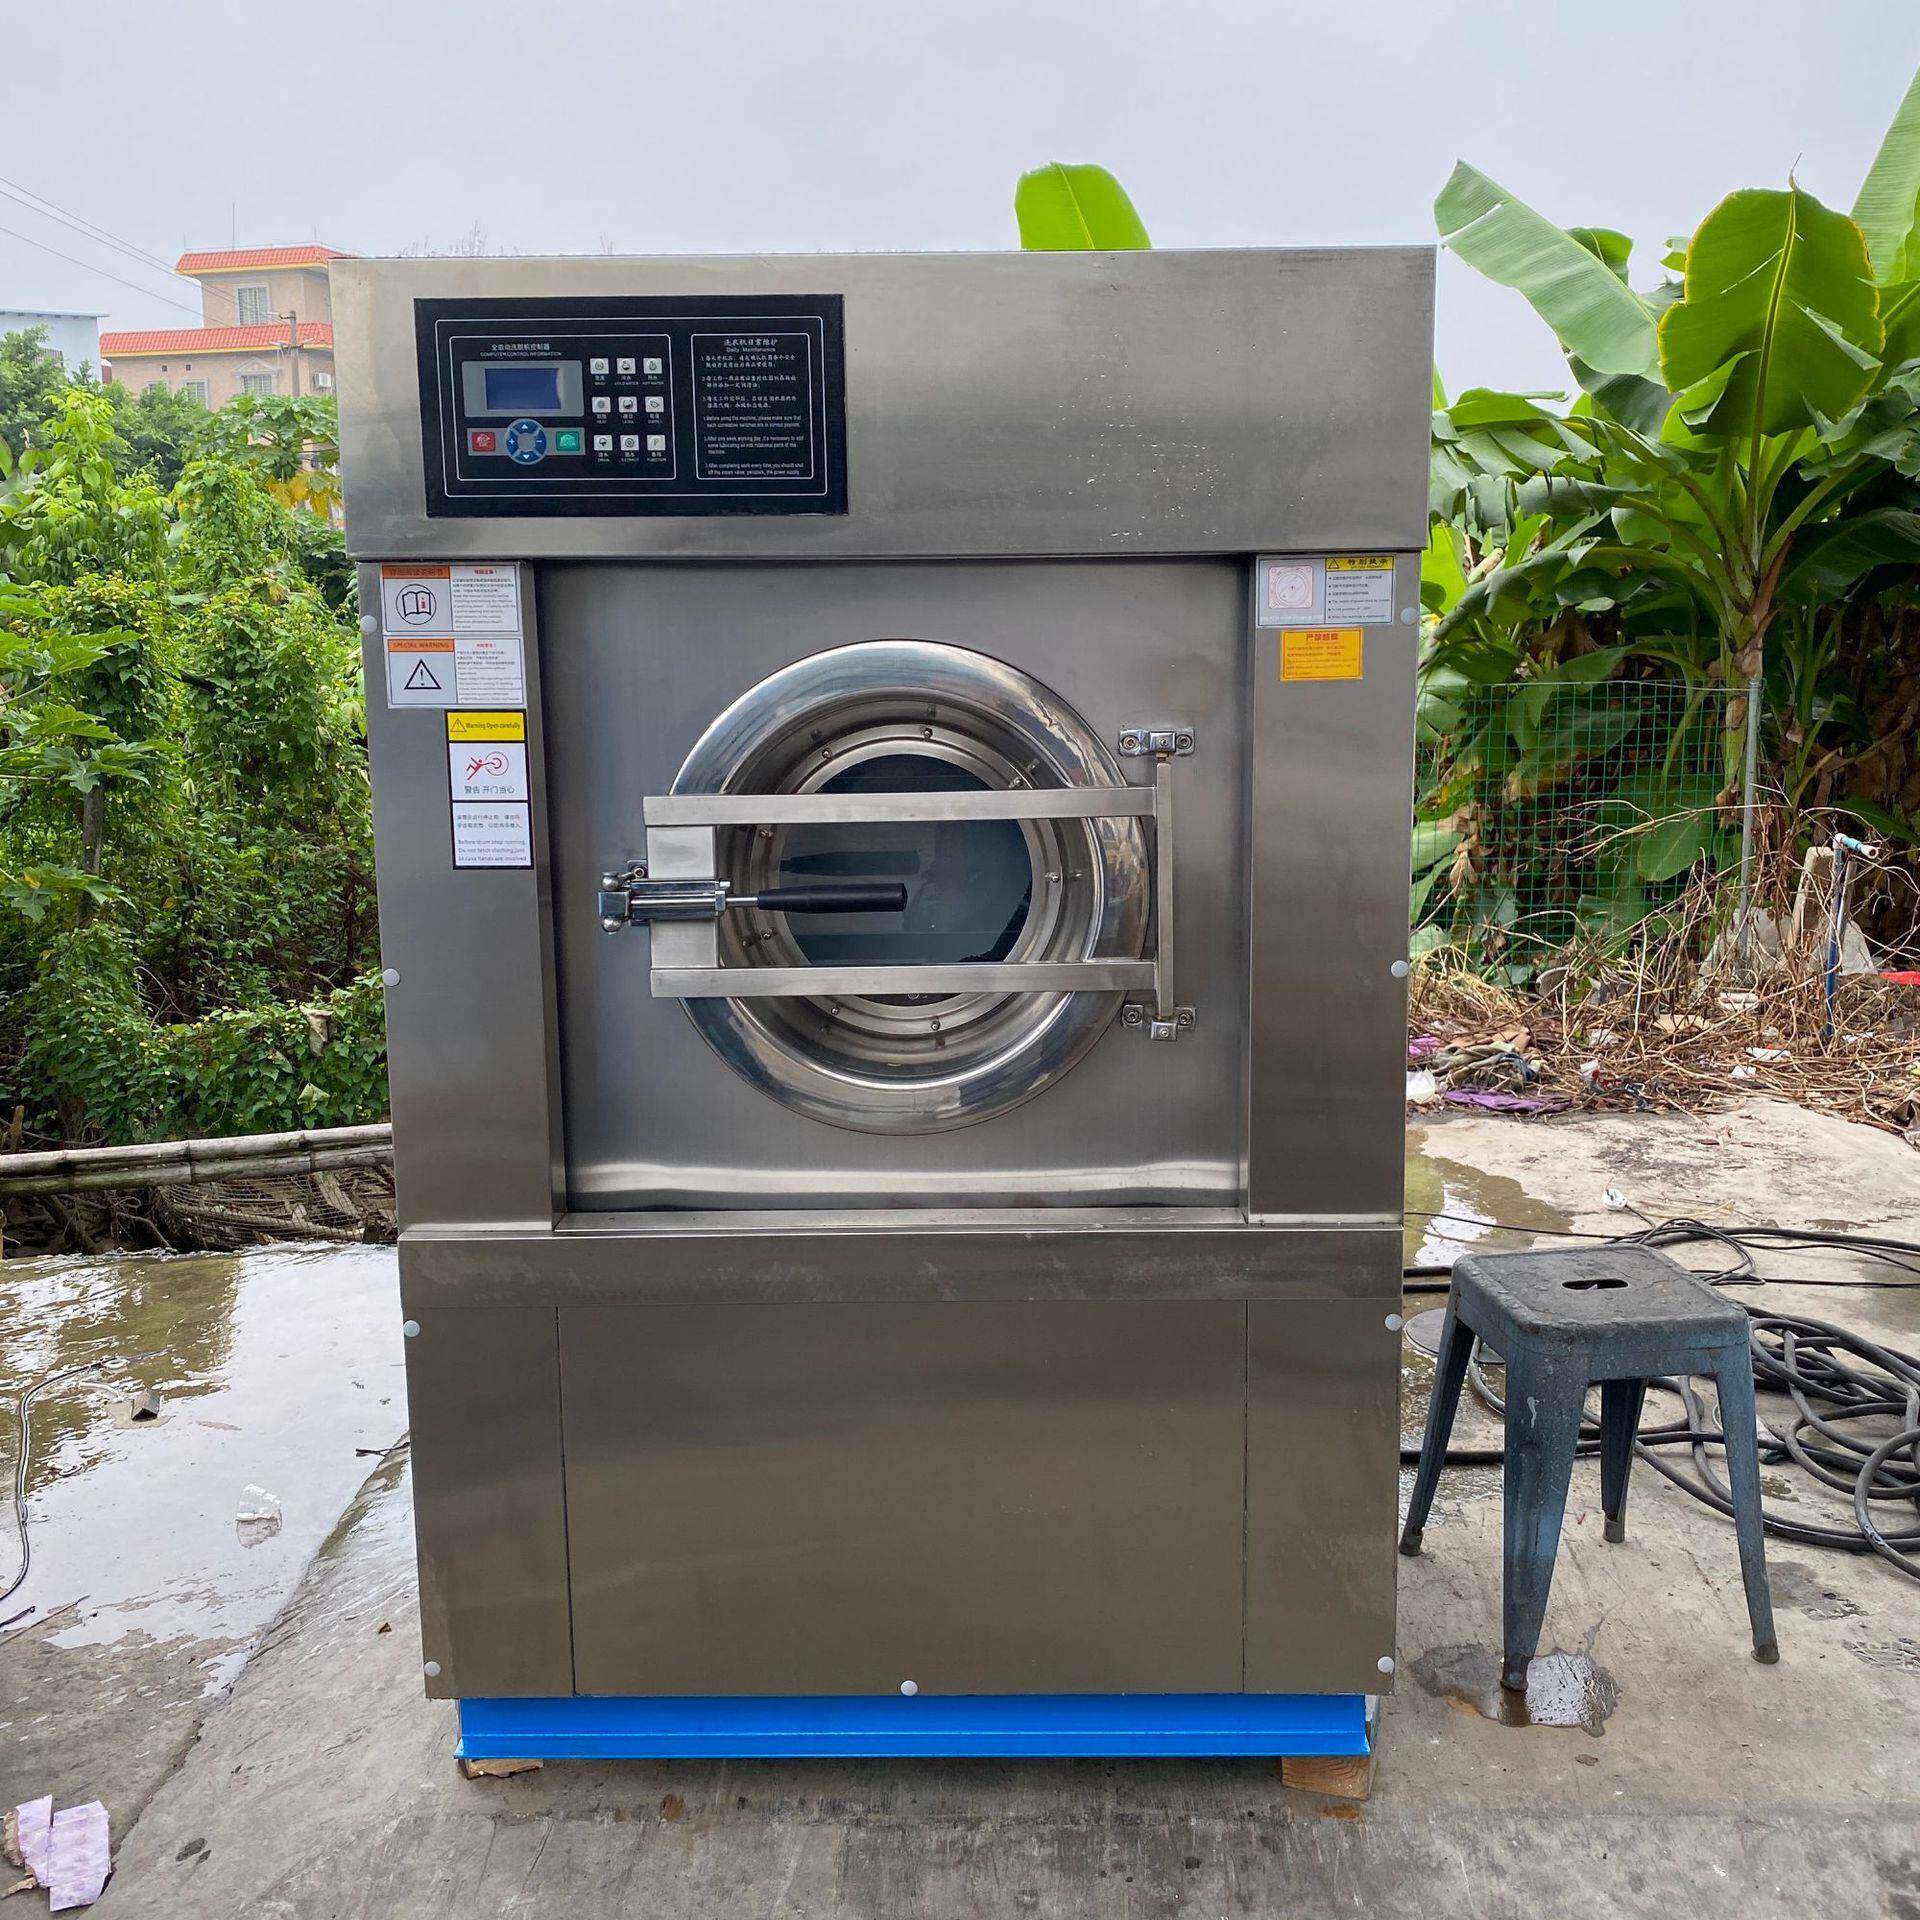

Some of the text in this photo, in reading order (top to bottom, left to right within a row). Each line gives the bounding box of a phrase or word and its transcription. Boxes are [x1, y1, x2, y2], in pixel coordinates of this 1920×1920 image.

[500, 722, 520, 730] carefully
[464, 785, 515, 794] 警告 开门当心
